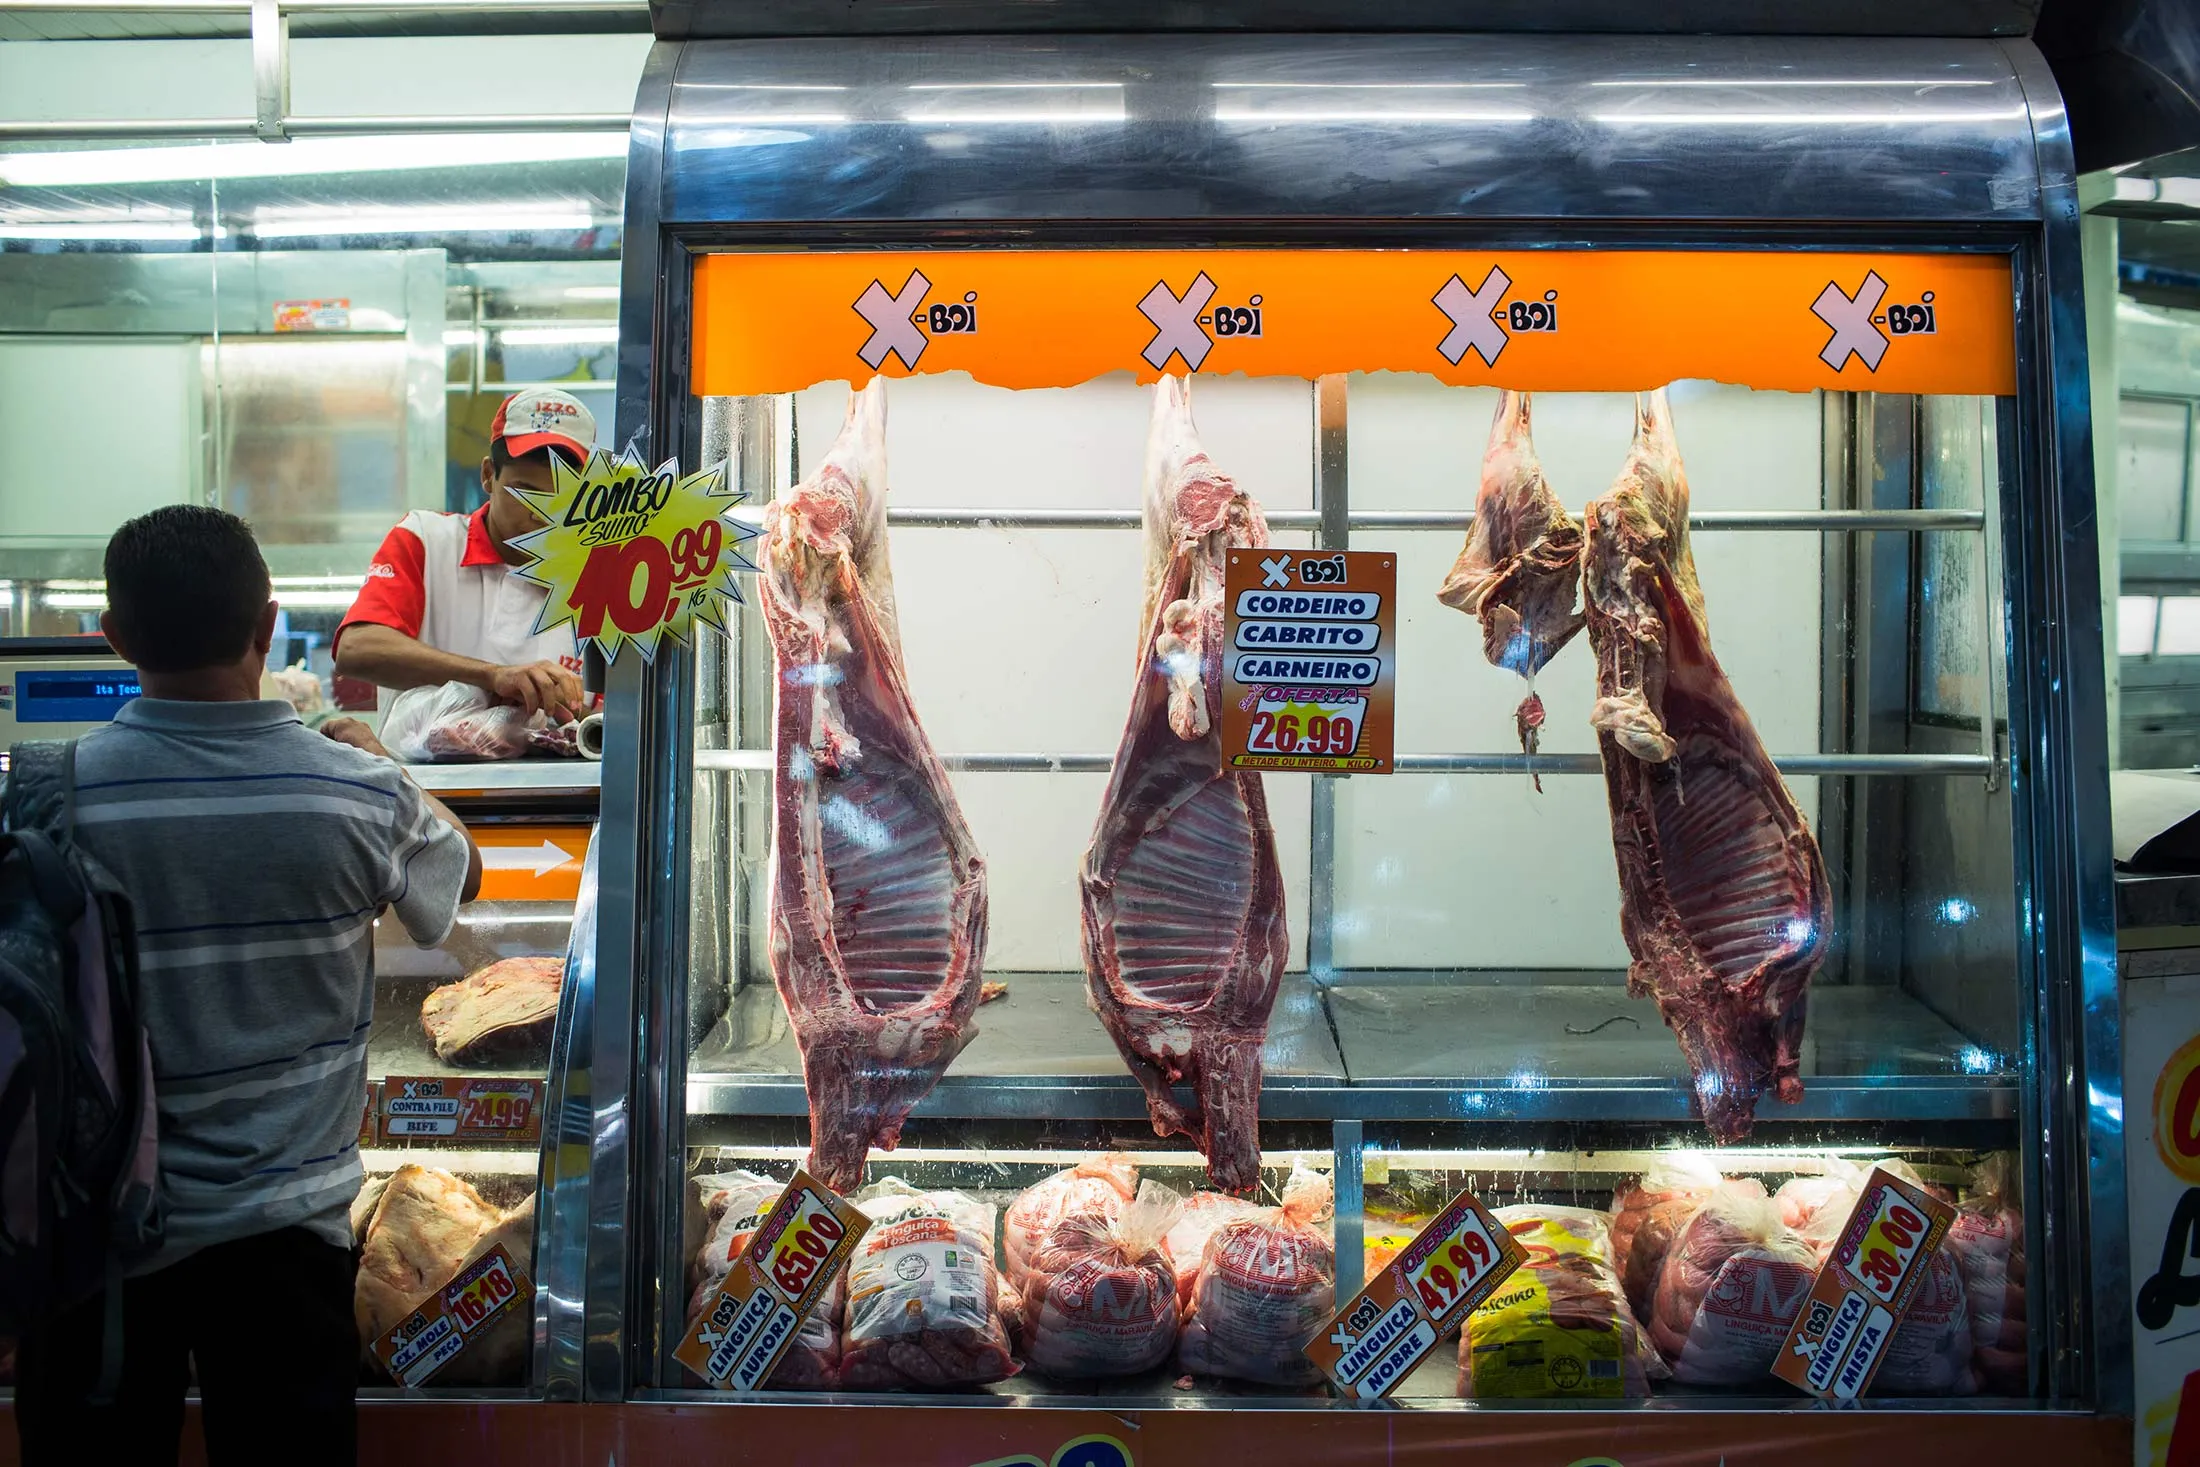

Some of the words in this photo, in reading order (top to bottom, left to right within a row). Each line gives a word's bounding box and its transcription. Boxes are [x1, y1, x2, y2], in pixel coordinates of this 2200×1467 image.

[536, 401, 577, 415] IZZO
[563, 473, 675, 527] LOMBO
[687, 587, 707, 609] KG
[1247, 596, 1366, 615] CORDEIRO
[1243, 626, 1364, 645] CABRITO
[559, 655, 583, 674] IZZ
[1242, 660, 1371, 679] CARNEIRO
[1264, 687, 1358, 703] OFERTA
[1252, 711, 1354, 754] 26,99
[1241, 756, 1280, 766] METADE
[1281, 757, 1296, 766] OU
[1346, 760, 1371, 769] KILO
[392, 1102, 431, 1113] CONTRA
[433, 1103, 454, 1113] FILE
[407, 1121, 438, 1131] BIFE
[753, 1190, 804, 1261] OFERTA
[882, 1220, 940, 1238] Linguiça
[883, 1229, 937, 1248] Toscana
[1404, 1208, 1466, 1272] OFERTA
[1839, 1187, 1885, 1265] OFERTA
[1926, 1219, 1947, 1248] PACOTE
[837, 1227, 860, 1256] PACOTE
[1861, 1205, 1923, 1293] 30,00
[1219, 1271, 1259, 1292] LINGUIÇA
[1417, 1231, 1491, 1312] 49,99
[1489, 1256, 1517, 1283] PACOTE
[451, 1269, 513, 1328] 16,18
[1478, 1287, 1537, 1317] oscana
[416, 1321, 449, 1350] MOLE
[711, 1291, 772, 1375] LINGUIÇA
[1341, 1305, 1415, 1378] LINGUIÇA
[1725, 1319, 1772, 1336] LINGUIÇA
[1810, 1297, 1862, 1381] LINGUIÇA
[433, 1337, 461, 1362] PEÇA
[740, 1312, 794, 1386] AURORA
[1370, 1333, 1424, 1392] NOBRE
[1841, 1325, 1881, 1390] MISTA
